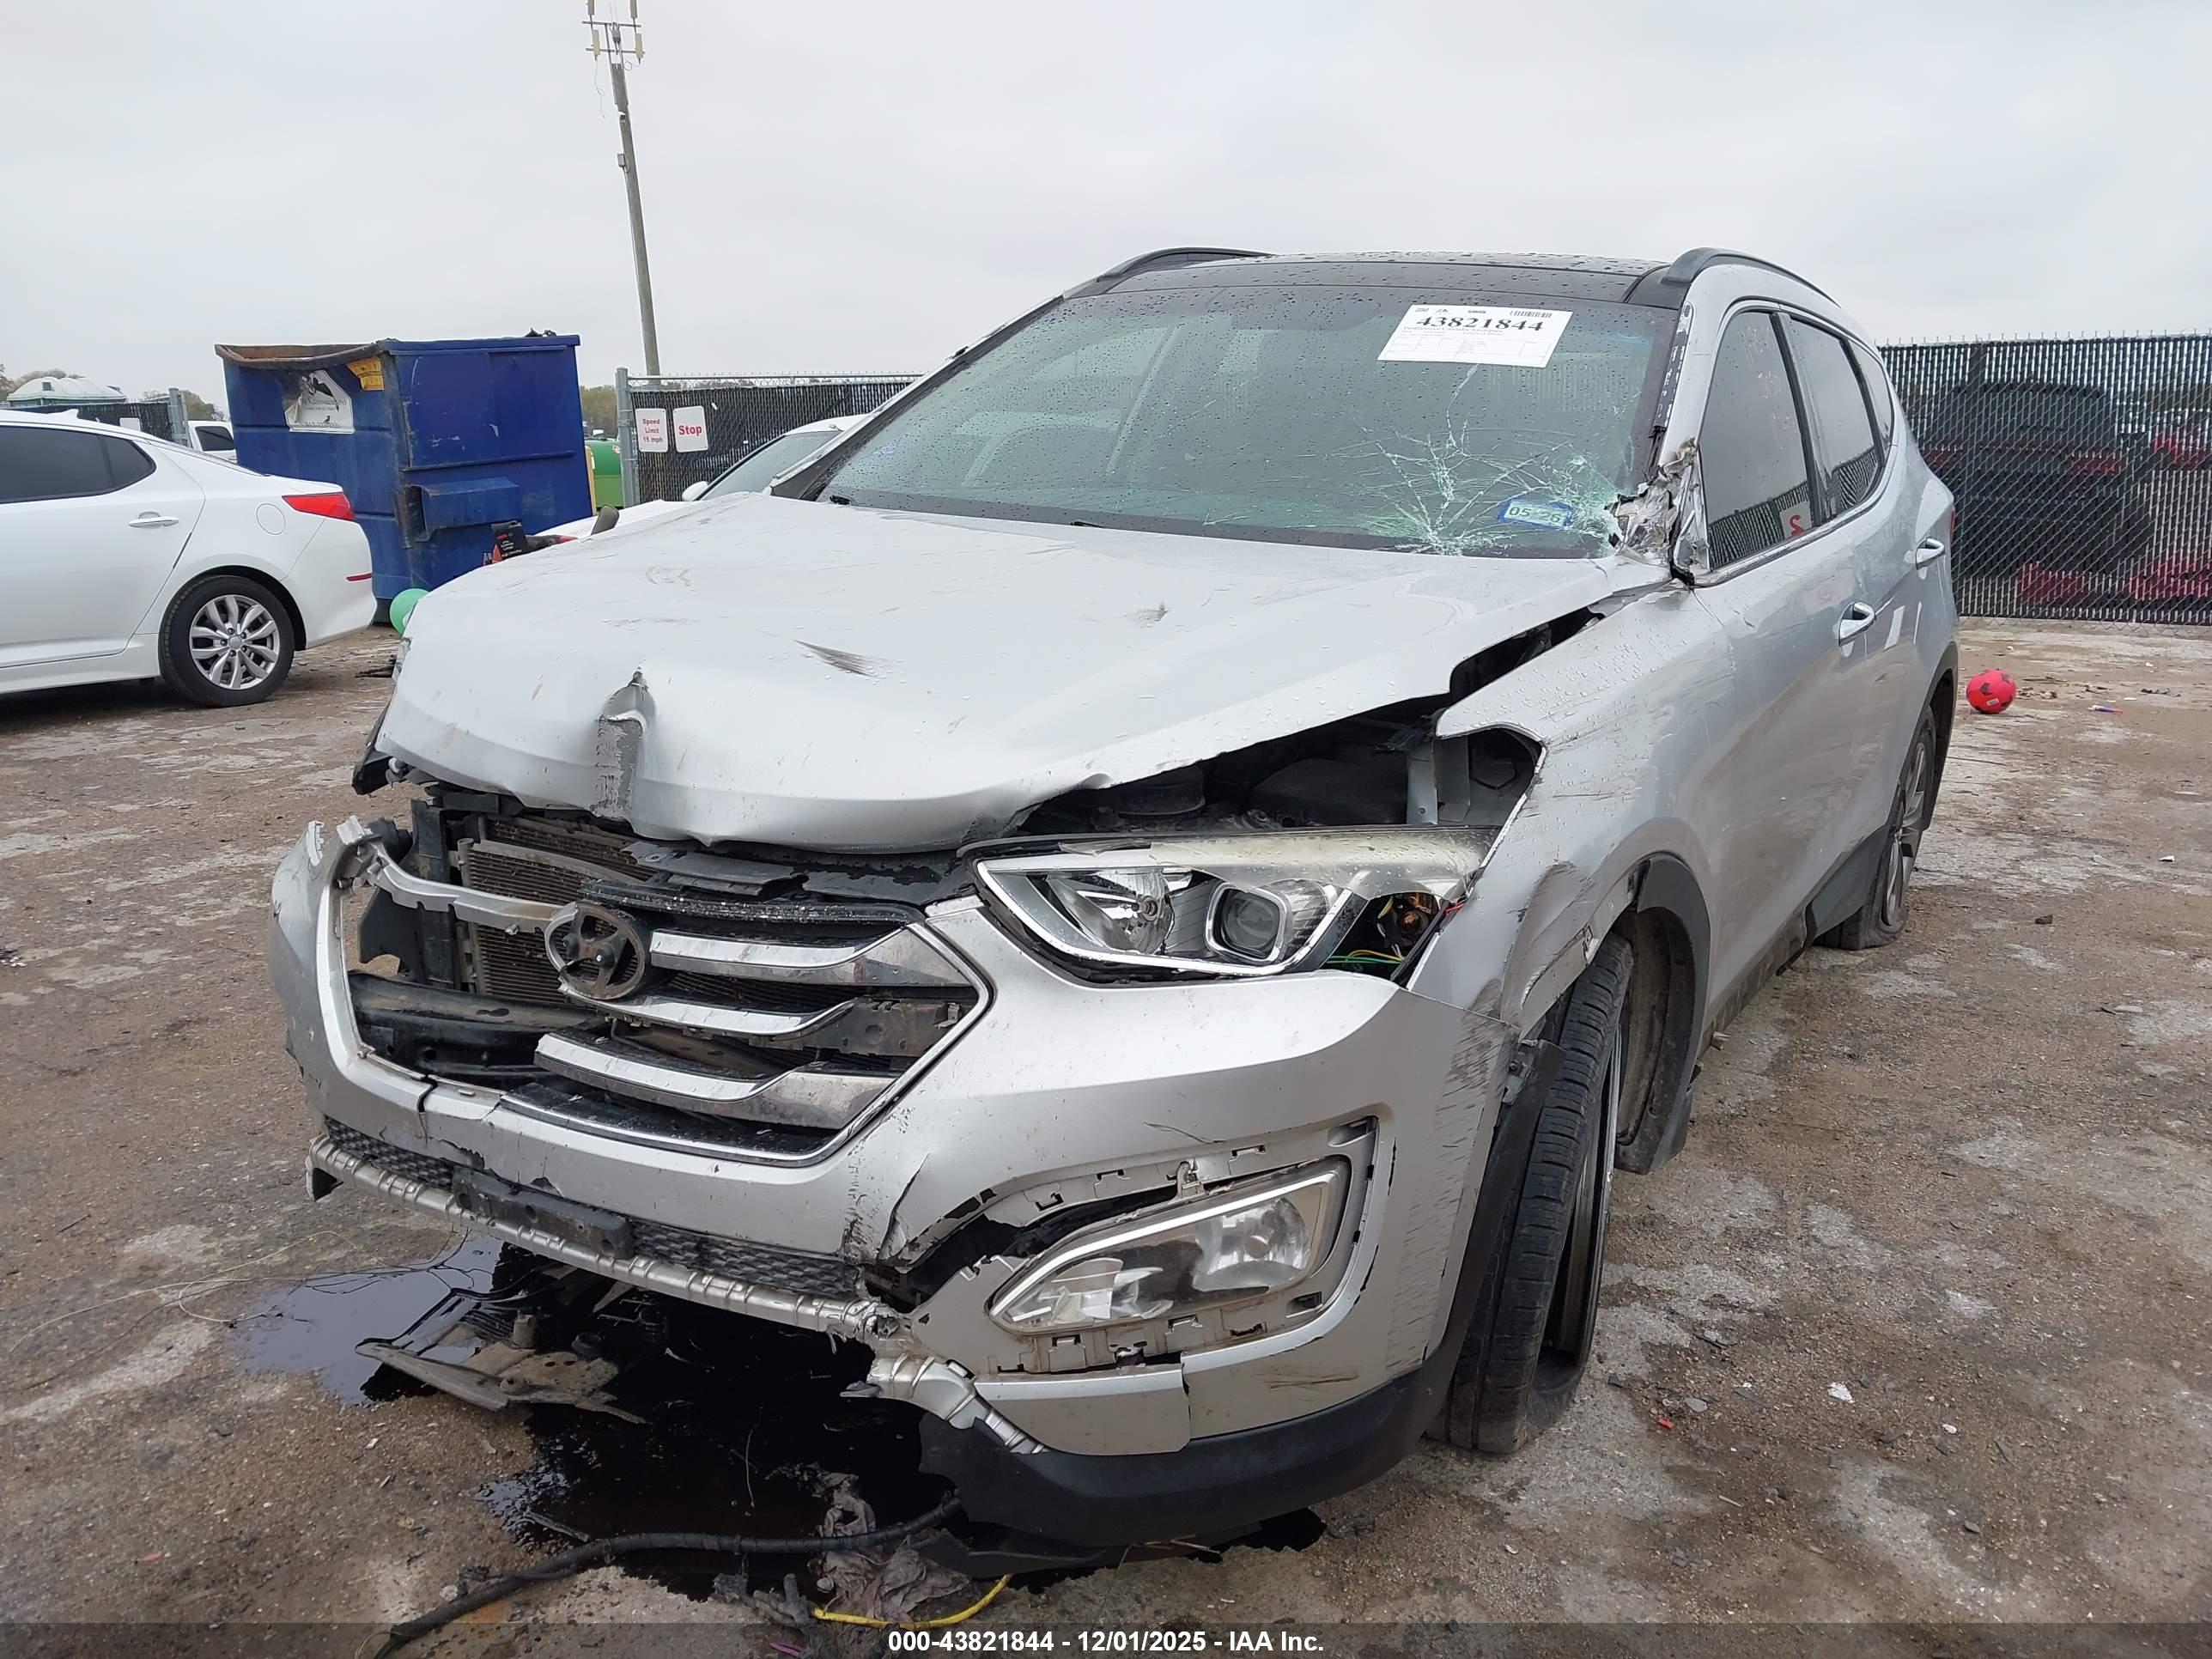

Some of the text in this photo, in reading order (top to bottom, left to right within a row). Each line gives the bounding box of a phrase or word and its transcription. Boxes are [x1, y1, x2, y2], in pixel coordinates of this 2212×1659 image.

[1416, 315, 1544, 331] 43821844
[678, 425, 702, 436] Stop
[1509, 506, 1562, 523] 05 26
